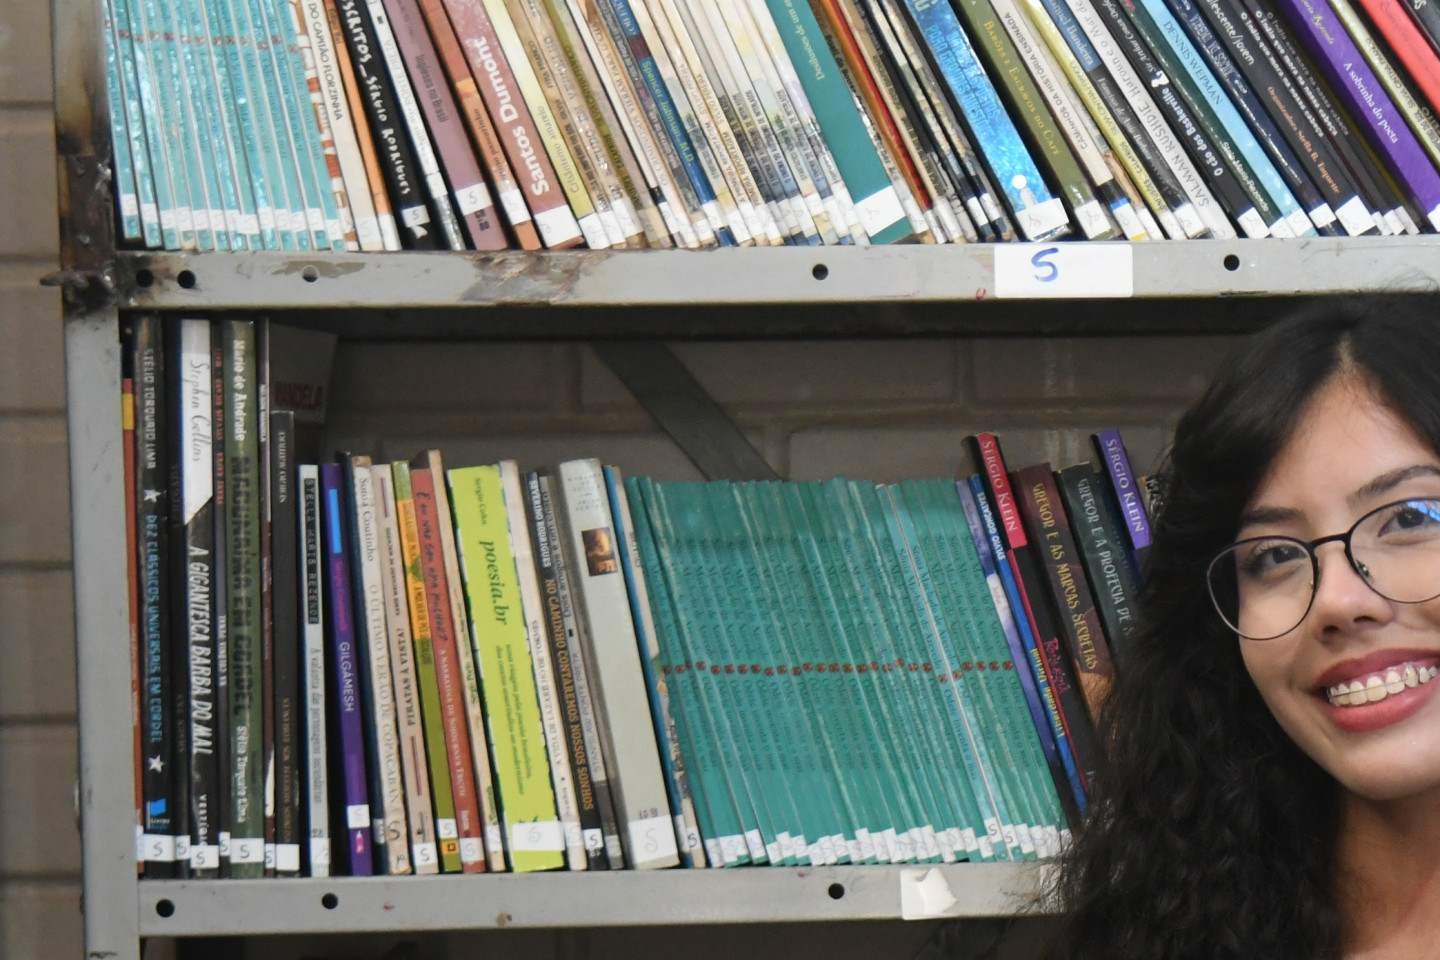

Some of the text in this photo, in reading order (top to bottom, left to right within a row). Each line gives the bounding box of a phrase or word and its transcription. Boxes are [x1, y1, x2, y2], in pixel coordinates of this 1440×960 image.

[470, 34, 519, 124] Dumont
[1003, 11, 1088, 150] CAMINHOS DA ENSINADA
[1114, 17, 1149, 63] Arthur Conan
[1162, 19, 1194, 61] DENNIS
[1187, 56, 1223, 107] WEPMAN
[321, 63, 345, 120] FLORZINHA
[1109, 56, 1210, 208] SALMAN RUSHDIE Haroun
[1160, 85, 1224, 176] O cão dos Baskerville
[1343, 61, 1399, 145] A sobrinha do poeta
[507, 124, 550, 197] Santos
[1032, 248, 1058, 282] S
[234, 394, 248, 440] Andrade
[996, 492, 1019, 531] KLEIN
[1075, 477, 1125, 605] GREGOR PROFECIA
[1122, 492, 1144, 532] KLEIN
[476, 537, 515, 626] poesia.br
[1029, 483, 1054, 528] GREGOR
[1055, 563, 1080, 609] MARCAS
[1070, 612, 1099, 670] SECRETAS
[146, 606, 161, 673] UNIVERSAIS
[187, 561, 213, 754] GIGANTESCA BARBA DO MAL
[544, 578, 594, 810] NO CAMINHO CONTAREMOS NOSSOS SONHOS
